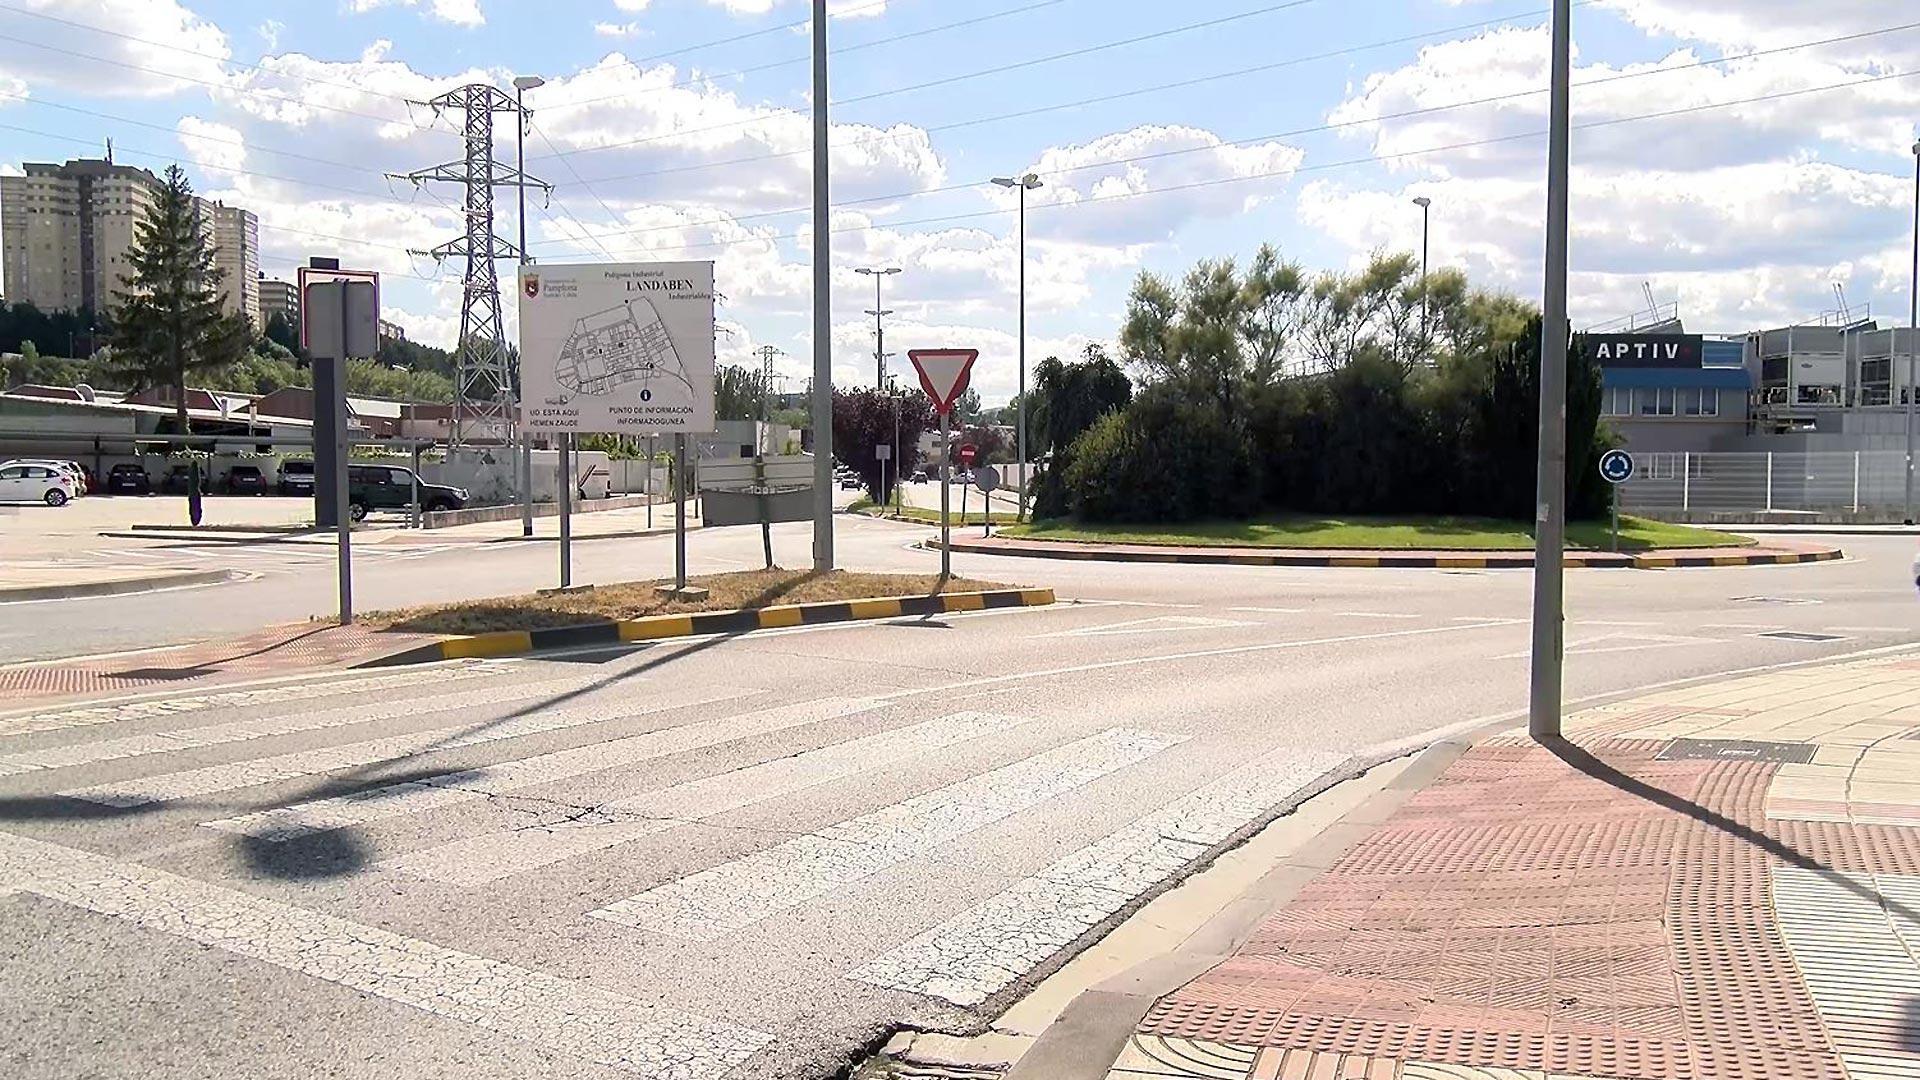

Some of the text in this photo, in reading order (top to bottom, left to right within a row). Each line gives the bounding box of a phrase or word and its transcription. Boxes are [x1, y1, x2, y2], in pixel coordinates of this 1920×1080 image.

[626, 279, 693, 291] LANDABEN
[1596, 342, 1679, 359] APTIV
[609, 405, 694, 414] PUNTO DE INFORMACIÓN
[529, 419, 554, 427] HEMEN
